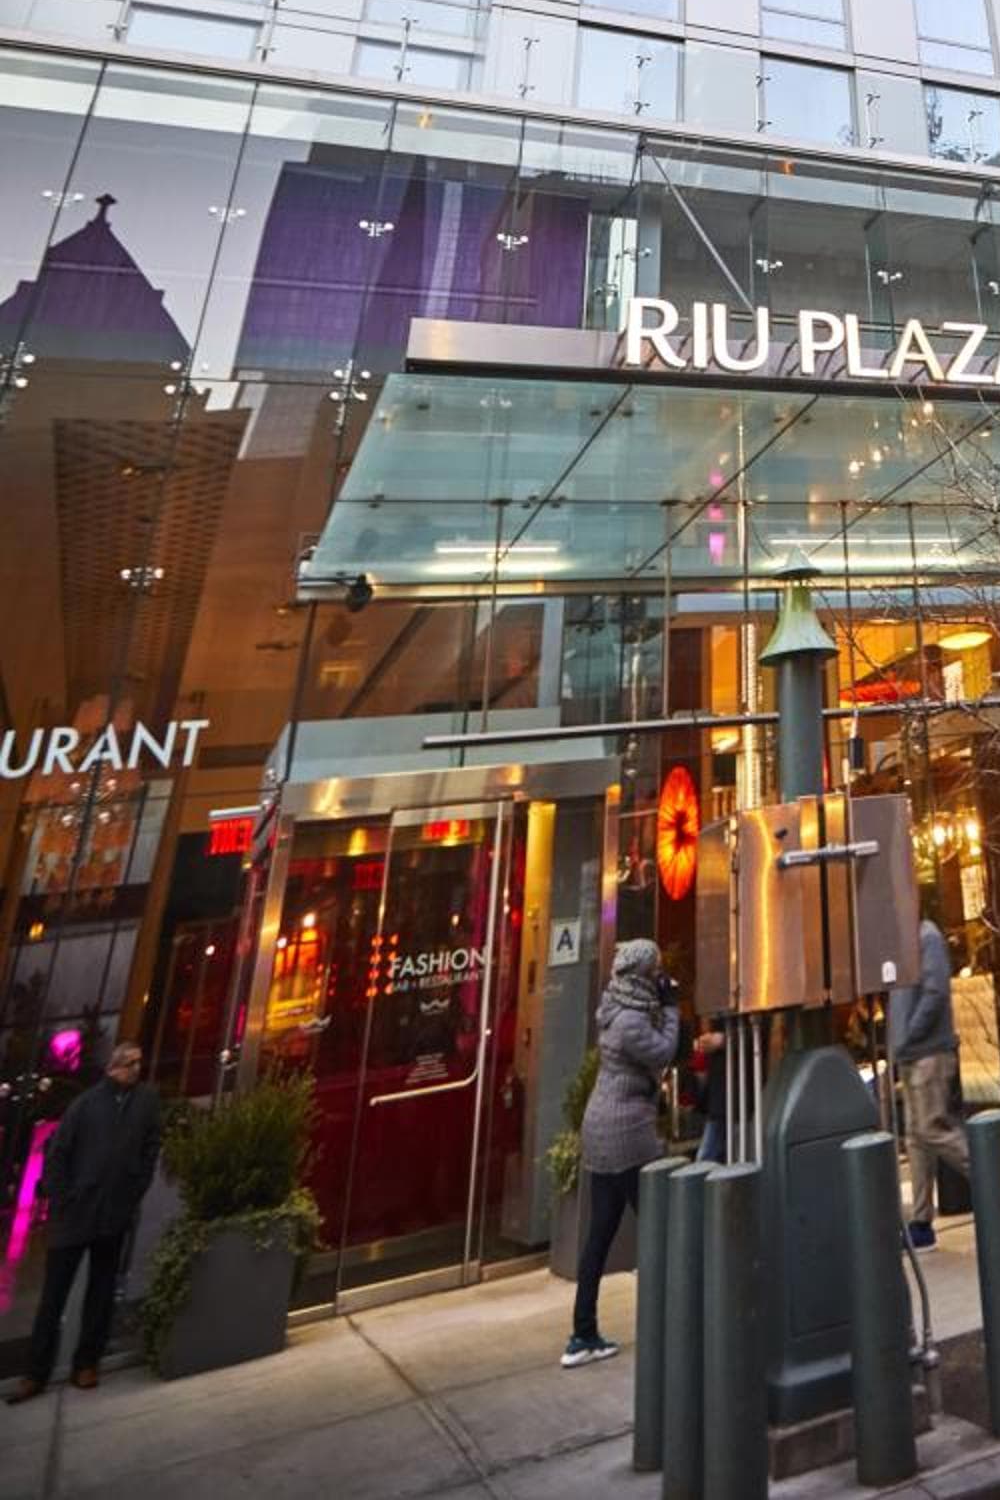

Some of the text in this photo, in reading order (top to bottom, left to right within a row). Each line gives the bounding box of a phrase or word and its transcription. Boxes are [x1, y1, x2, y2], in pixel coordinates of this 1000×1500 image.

[624, 297, 770, 373] RIU
[556, 927, 573, 952] A
[390, 946, 489, 979] FASHION
